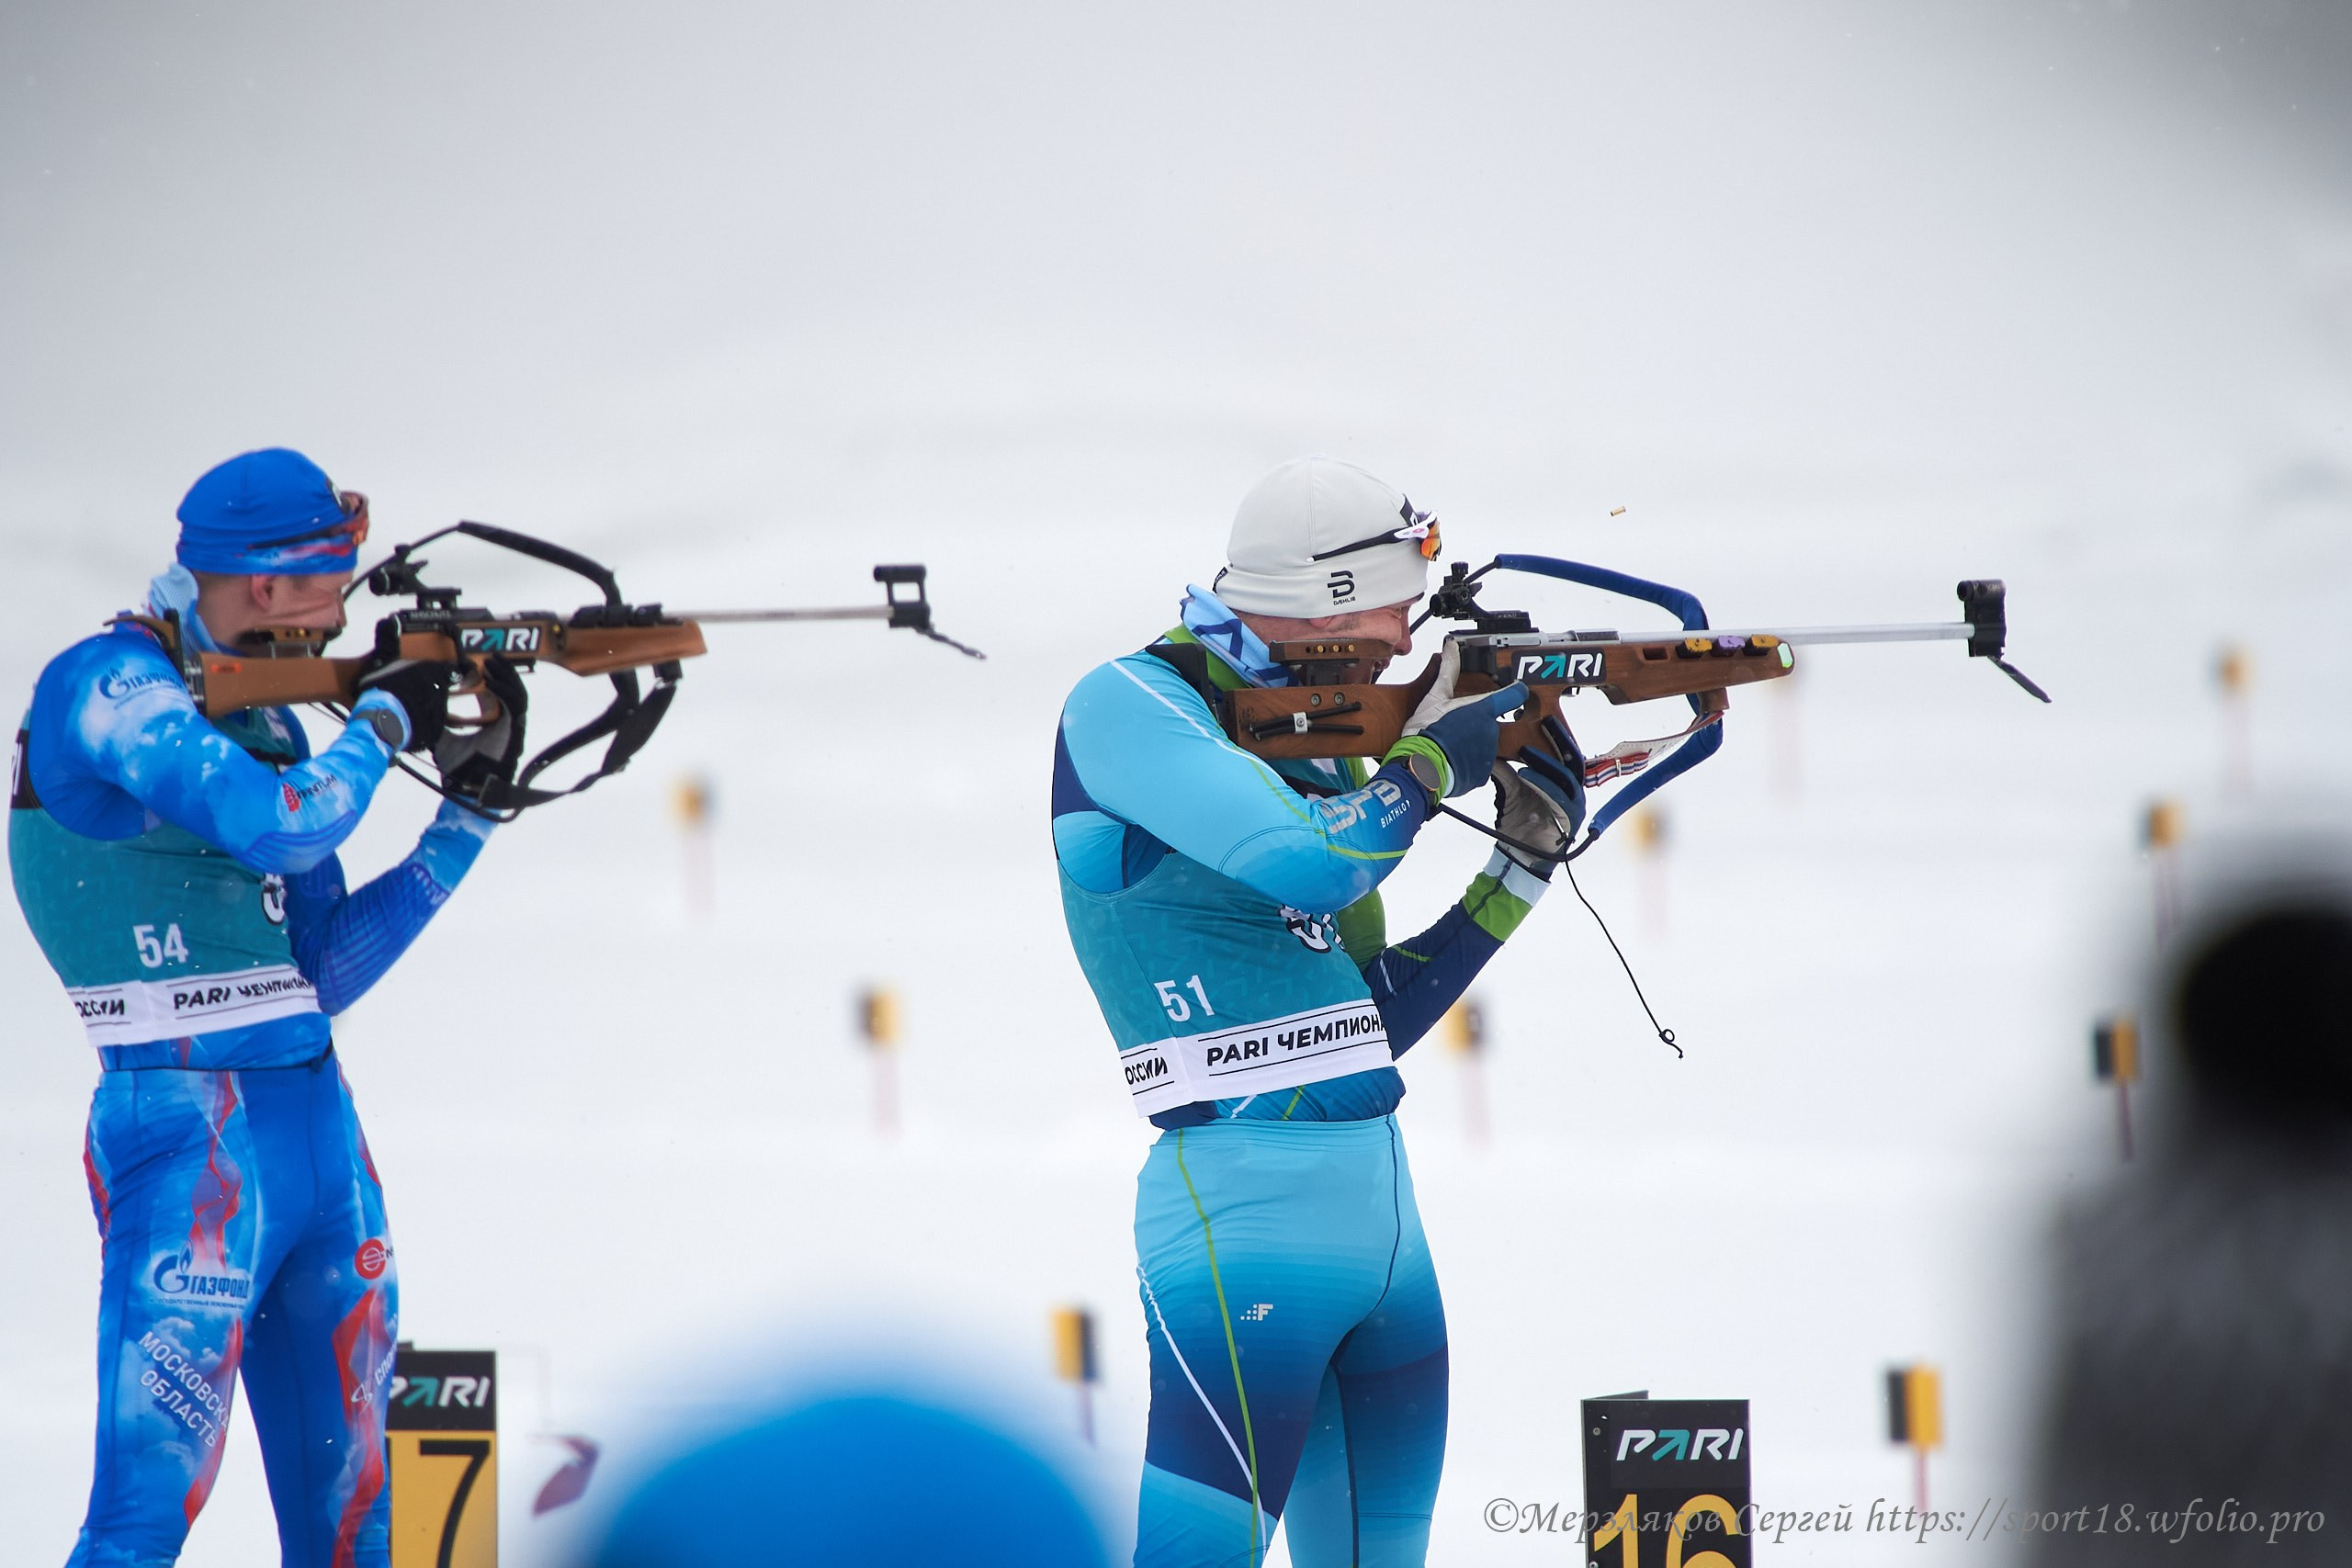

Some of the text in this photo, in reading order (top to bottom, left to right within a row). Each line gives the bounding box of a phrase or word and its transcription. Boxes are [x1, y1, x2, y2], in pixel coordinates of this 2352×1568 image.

[460, 626, 540, 651] PARI
[1517, 652, 1603, 680] PARI
[132, 922, 189, 968] 54
[173, 986, 232, 1010] PARI
[1154, 975, 1216, 1022] 51
[1206, 1037, 1269, 1066] PARI
[140, 1370, 217, 1449] ОБЛАСТЬ
[1615, 1428, 1744, 1461] PARI
